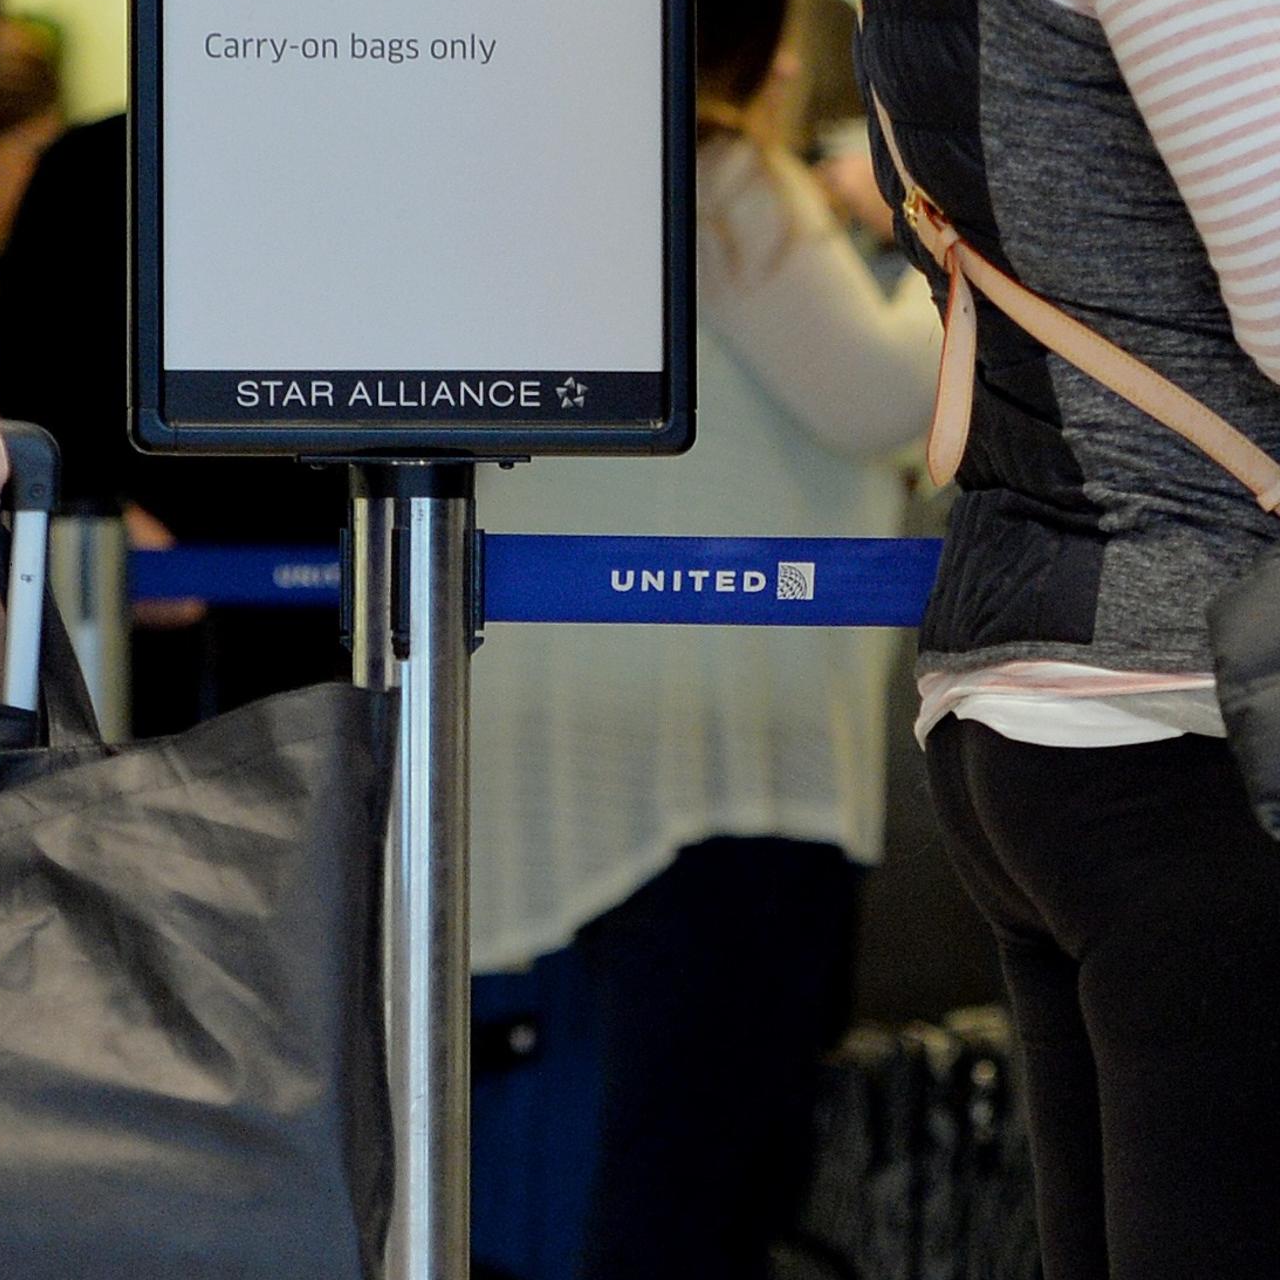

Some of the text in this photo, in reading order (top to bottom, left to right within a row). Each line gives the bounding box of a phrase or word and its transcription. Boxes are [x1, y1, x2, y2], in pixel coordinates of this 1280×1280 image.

[205, 33, 497, 66] Carry-on bags only
[236, 381, 542, 409] STAR ALLIANCE
[610, 569, 767, 594] UNITED
